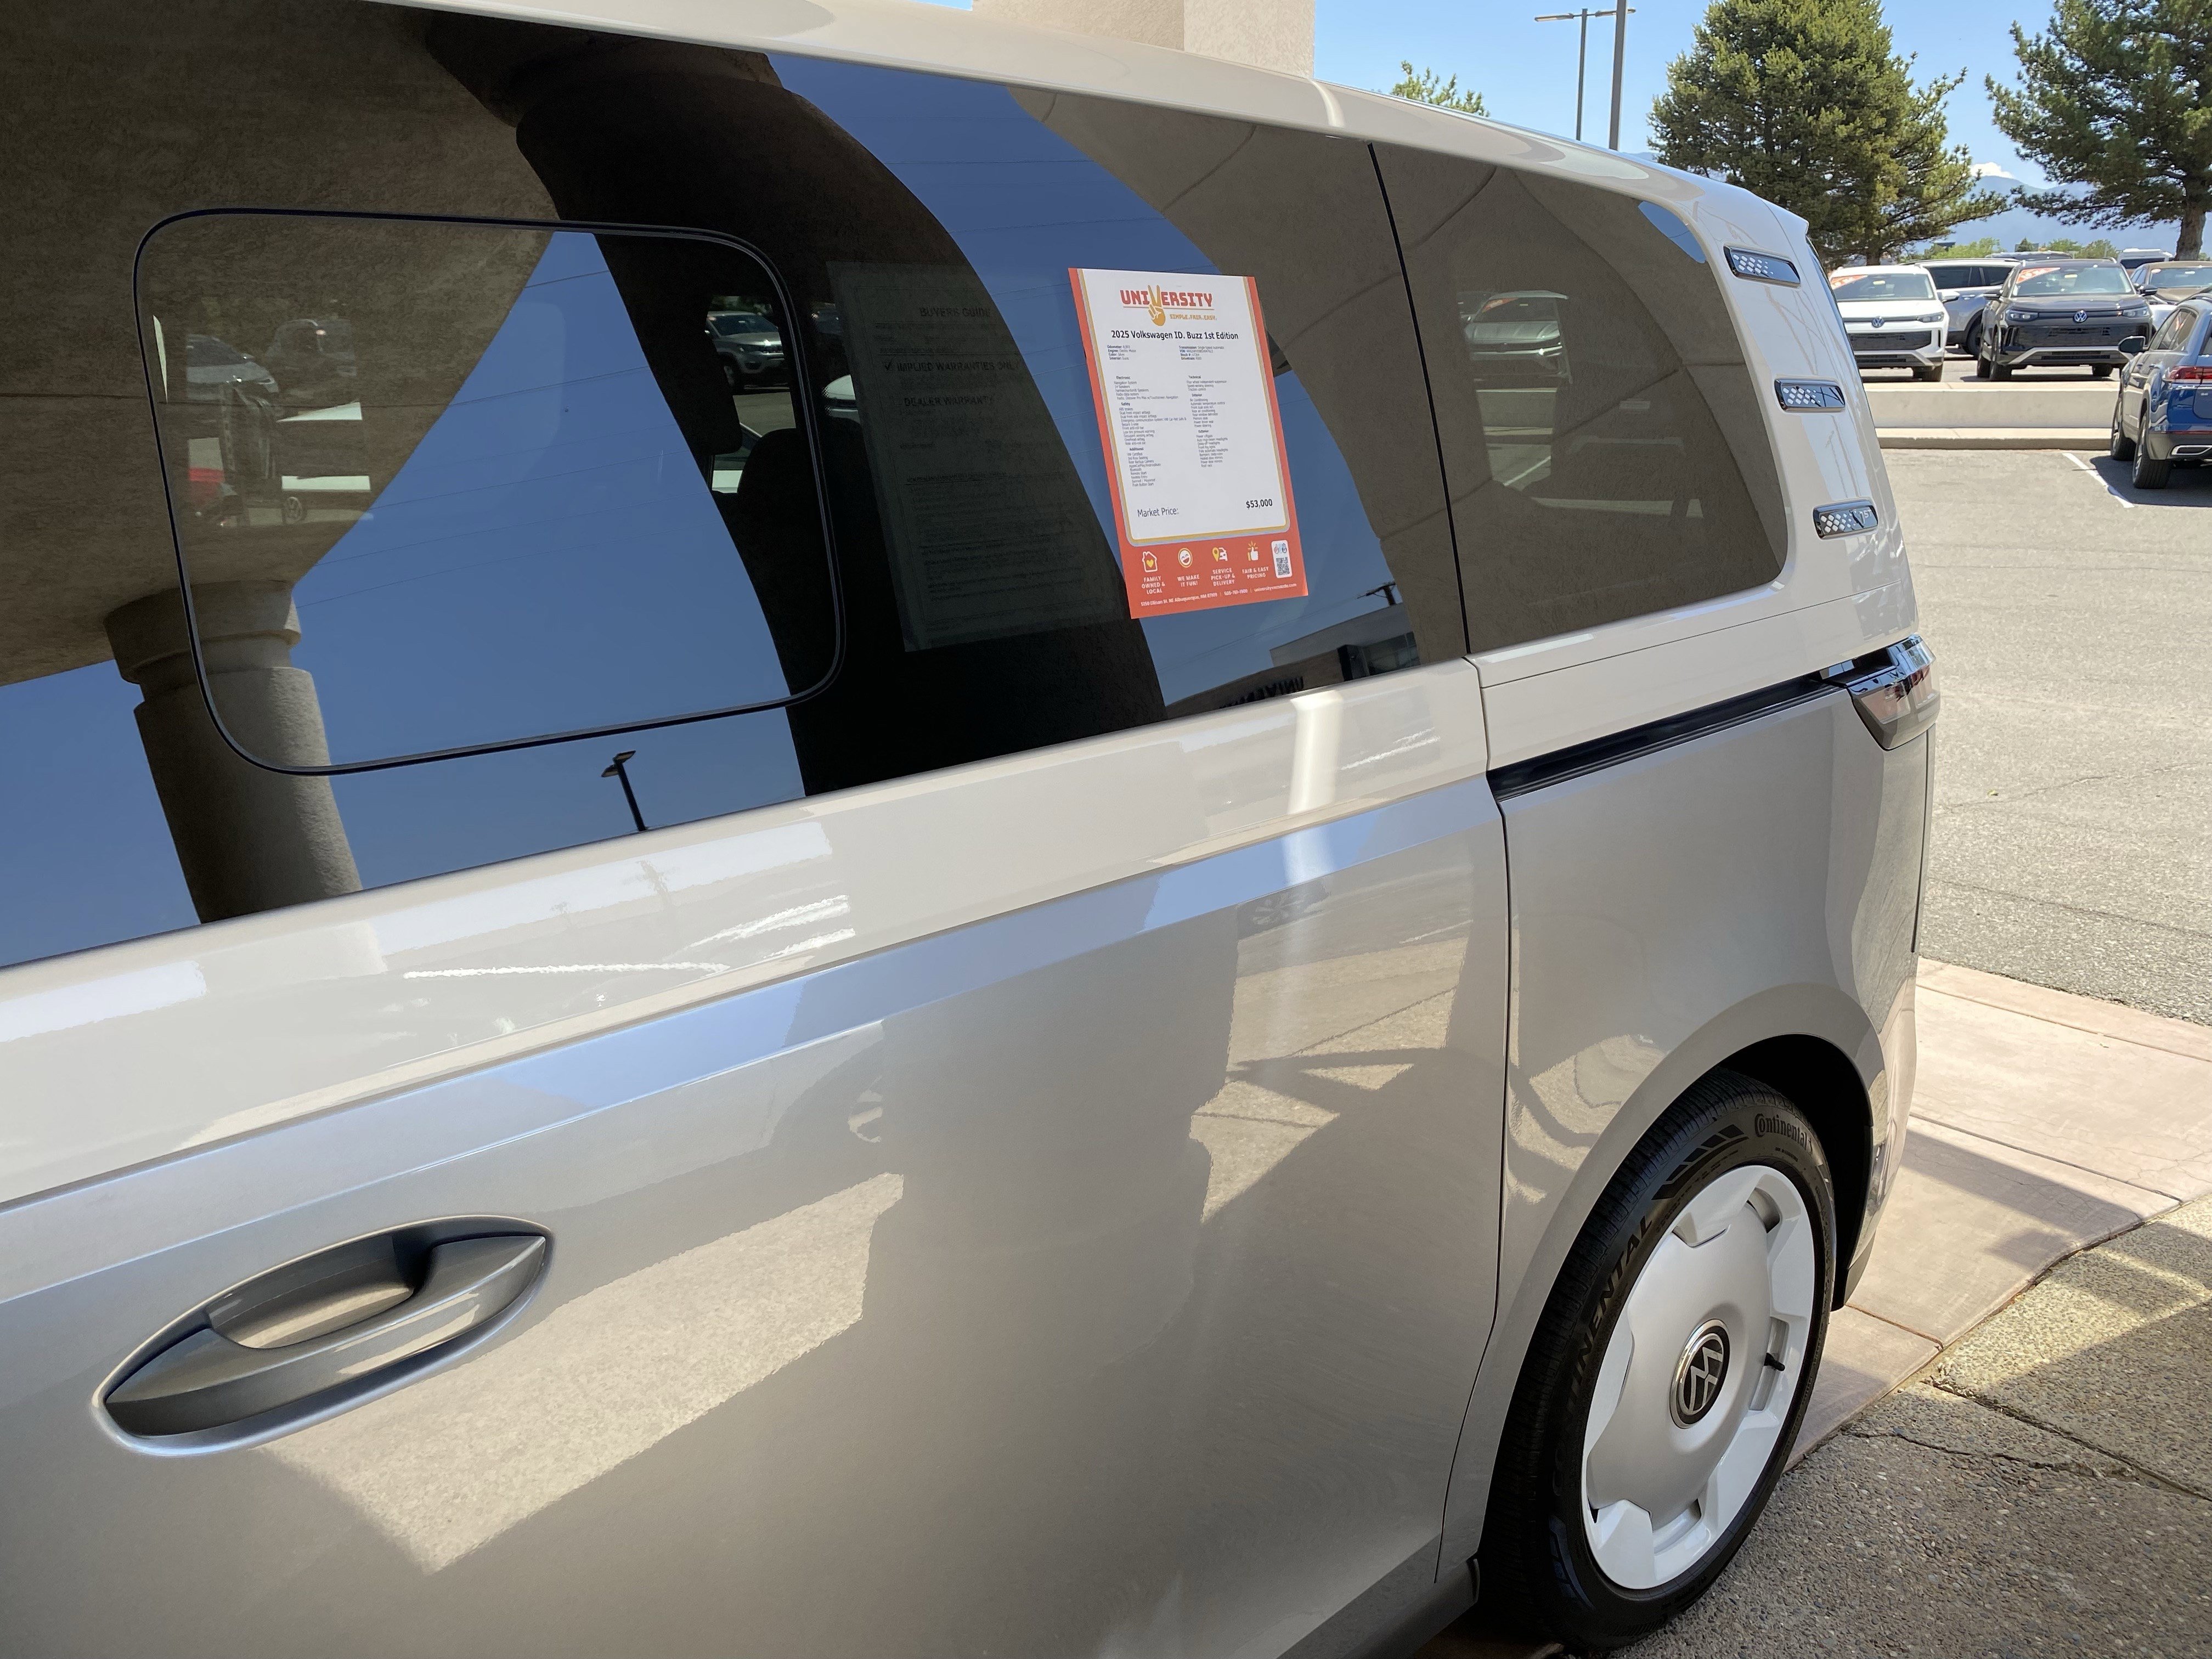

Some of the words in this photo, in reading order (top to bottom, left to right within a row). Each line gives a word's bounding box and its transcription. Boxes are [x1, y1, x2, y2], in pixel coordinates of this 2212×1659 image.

[1120, 285, 1213, 307] UNIVERSITY
[920, 307, 959, 317] BUYERS
[962, 307, 990, 317] GUIDE
[1111, 330, 1130, 339] 2025
[1131, 330, 1173, 341] Volkswagen
[1175, 331, 1185, 340] ID.
[1187, 331, 1202, 340] Buzz
[1204, 331, 1214, 340] 1st
[1216, 331, 1238, 340] Edition
[898, 363, 933, 371] IMPLIED
[935, 361, 995, 370] WARRANTIES
[904, 397, 942, 407] DEALER
[944, 396, 993, 405] WARRANTY
[1246, 499, 1273, 509] $53,000
[1137, 508, 1160, 517] Market
[1161, 507, 1179, 516] Price:
[1754, 1113, 1807, 1150] Continental
